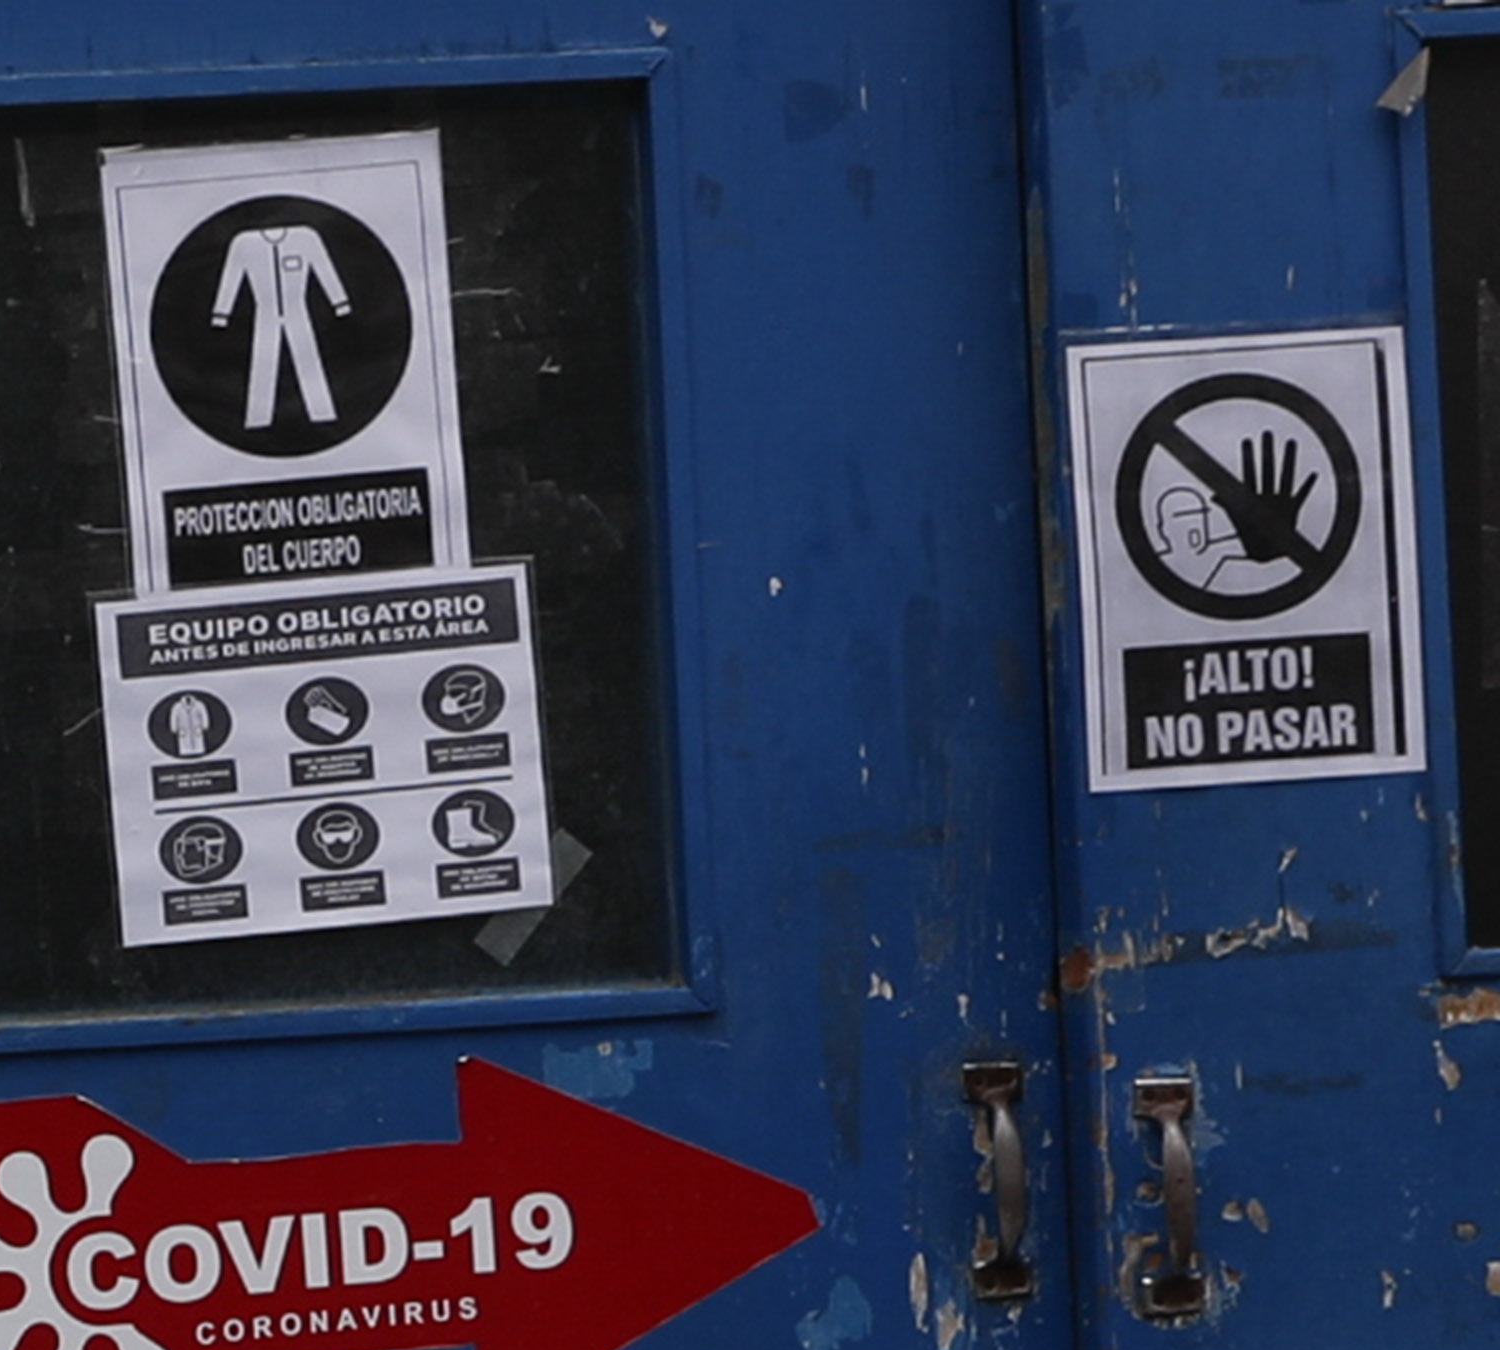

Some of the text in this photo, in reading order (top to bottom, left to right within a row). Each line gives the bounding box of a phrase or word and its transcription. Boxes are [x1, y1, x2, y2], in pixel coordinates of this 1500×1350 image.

[174, 487, 422, 537] PROTECCION OBLIGATORIA
[243, 537, 362, 574] DEL CUERPO
[149, 594, 485, 645] EQUIPO OBLIGATORIO
[150, 619, 489, 665] ANTES DE INGRESAR A ESTA ÁREA
[1184, 646, 1314, 702] ¡ALTO!
[1145, 703, 1358, 760] NO PASAR
[64, 1191, 575, 1312] COVID-19
[194, 1296, 480, 1346] CORONAVIRUS
